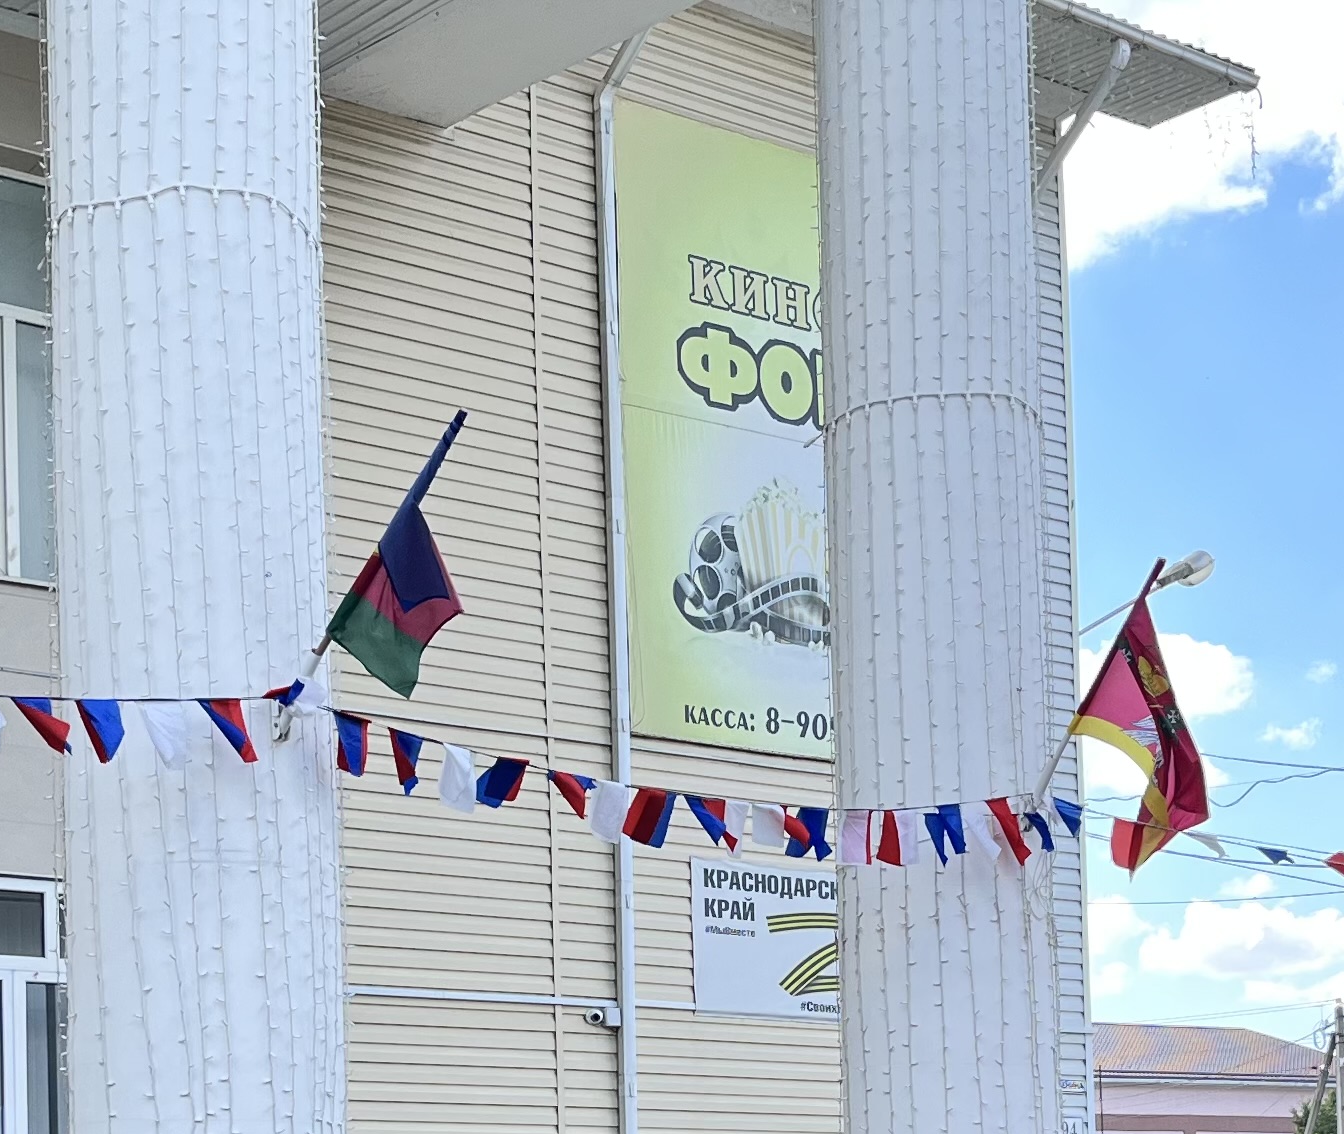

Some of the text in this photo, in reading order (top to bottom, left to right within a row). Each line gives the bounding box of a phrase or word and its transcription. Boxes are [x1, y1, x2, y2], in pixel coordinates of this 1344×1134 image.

[687, 254, 821, 331] КИН
[676, 321, 824, 431] ФО
[684, 704, 833, 740] КАССА: 8-90
[704, 896, 755, 921] КРАЙ
